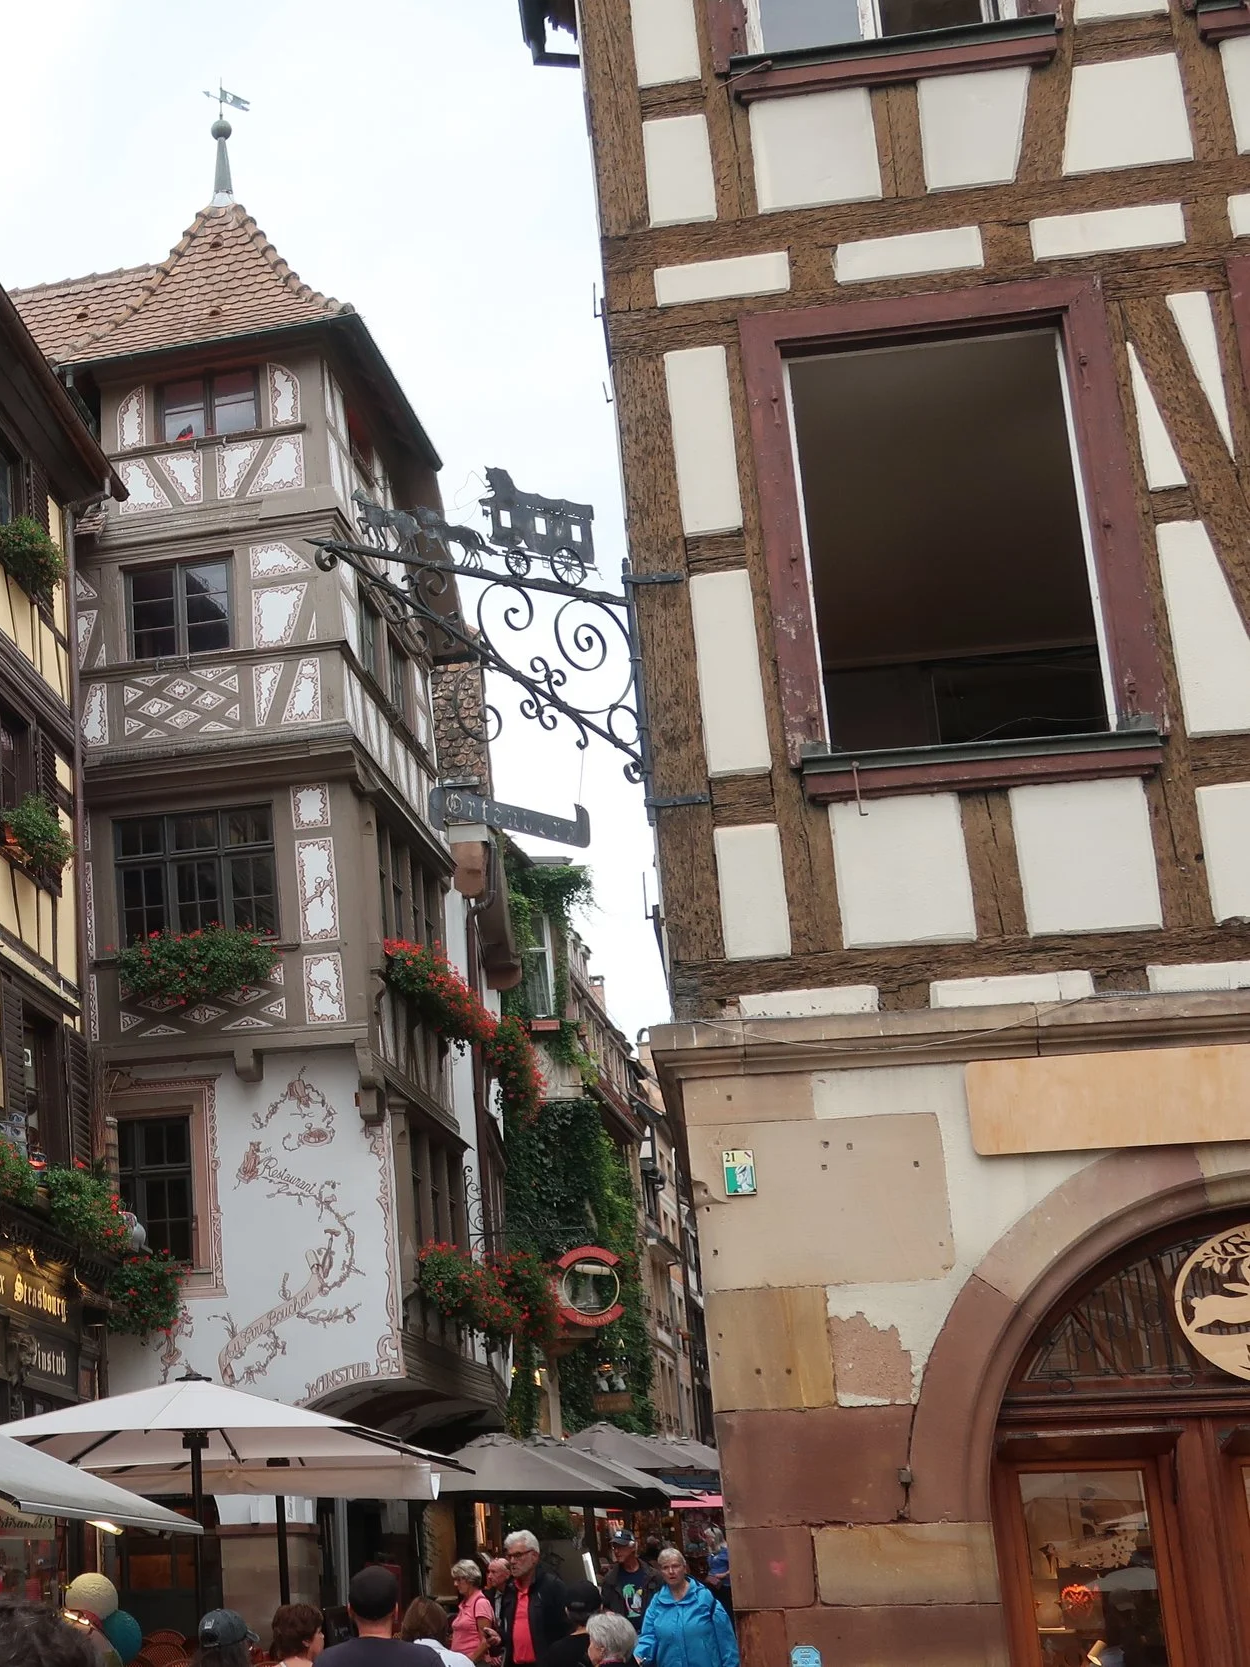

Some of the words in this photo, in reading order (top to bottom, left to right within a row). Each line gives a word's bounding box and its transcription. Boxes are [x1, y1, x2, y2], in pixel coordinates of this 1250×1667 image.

[725, 1152, 736, 1162] 21
[258, 1156, 318, 1196] Restaurant
[14, 1273, 68, 1323] Strasbourg
[266, 1291, 314, 1327] Bouchon
[34, 1341, 67, 1377] instub
[305, 1362, 371, 1398] WINSTUB
